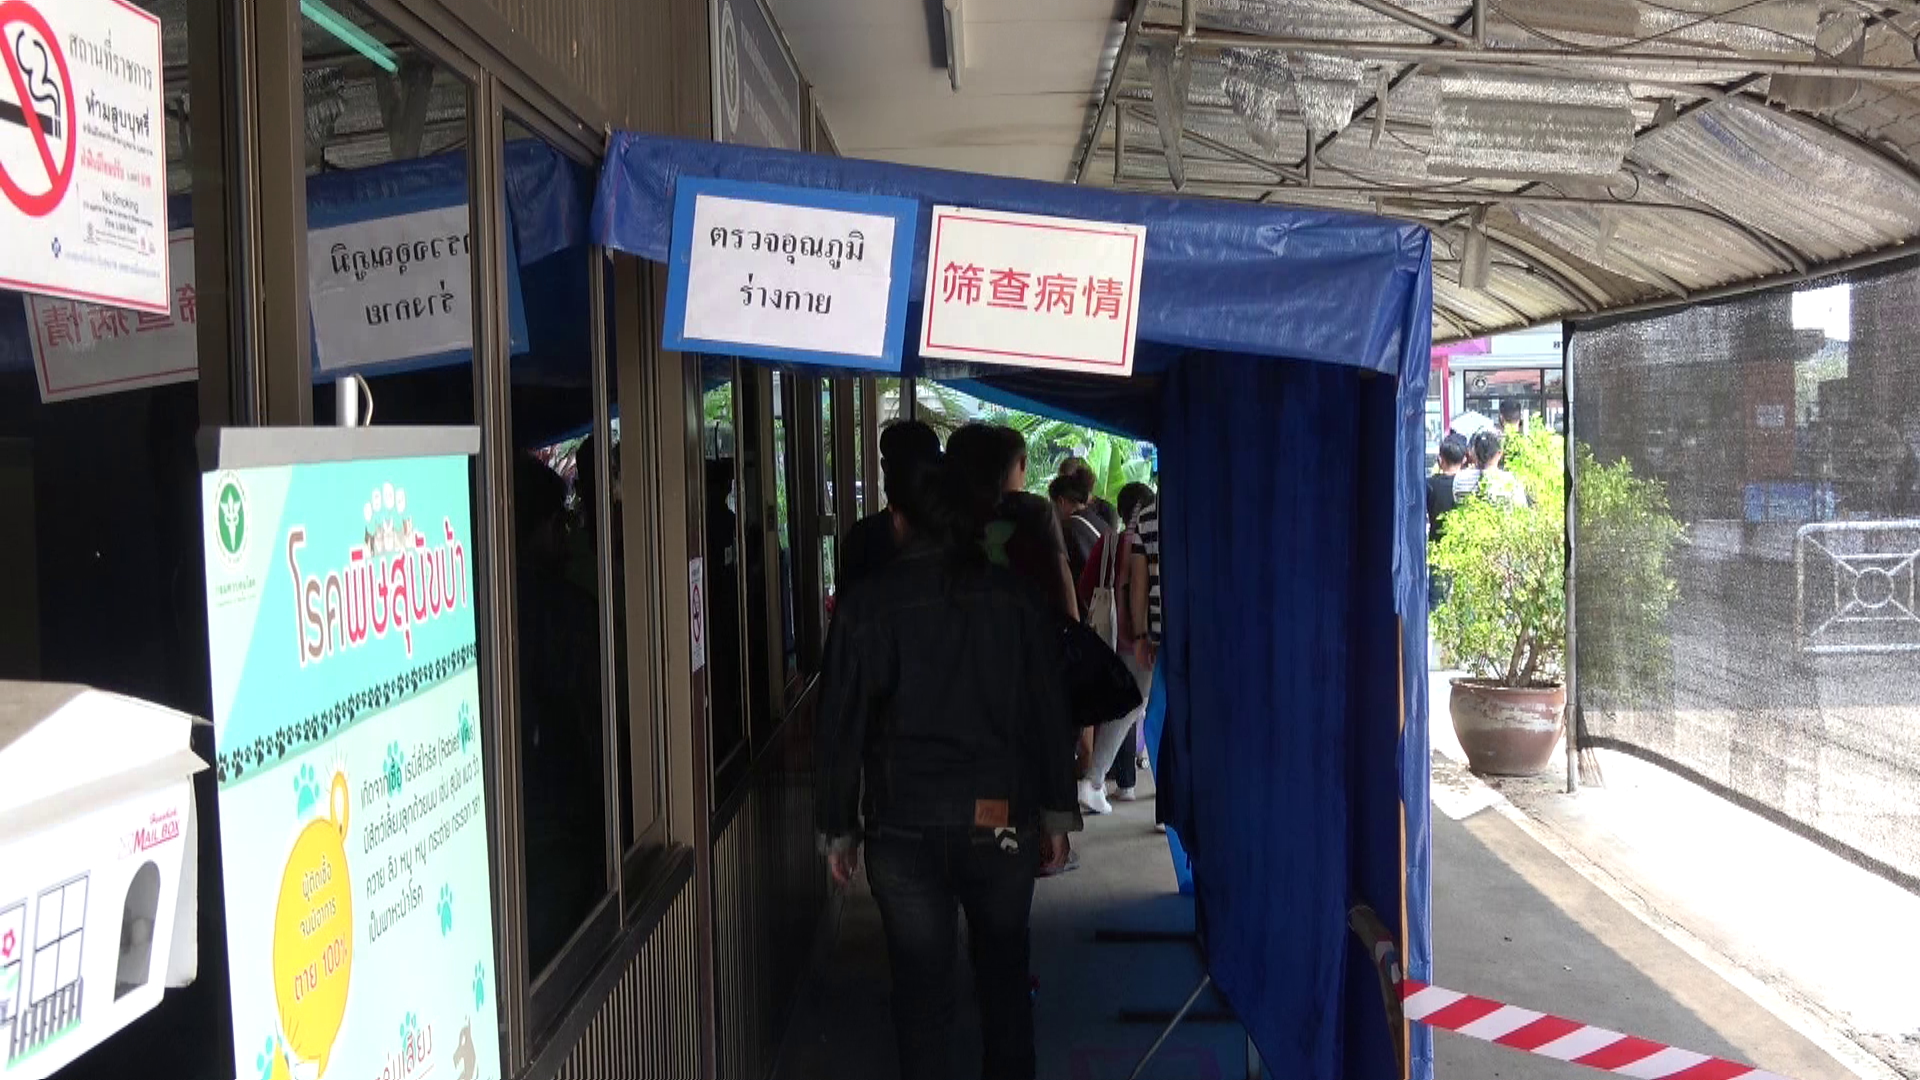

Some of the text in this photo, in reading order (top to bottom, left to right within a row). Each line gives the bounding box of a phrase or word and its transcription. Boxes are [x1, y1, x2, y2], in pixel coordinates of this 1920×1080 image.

[70, 28, 152, 91] สถานที่ราชการ
[86, 89, 150, 141] ห้ามสูบบุหรี่
[112, 192, 139, 213] Smoking
[710, 226, 865, 270] ตรวจอุณภูมิ
[739, 273, 831, 315] ร่างกาย
[942, 261, 1124, 321] 筛查病情
[289, 519, 466, 662] โรคพิษสุนัขบ้า
[133, 820, 180, 853] MAIL BOX
[367, 866, 385, 900] ควาย
[369, 877, 424, 944] เป็นพาหะนำโรค
[294, 932, 348, 1001] ตาย 100%
